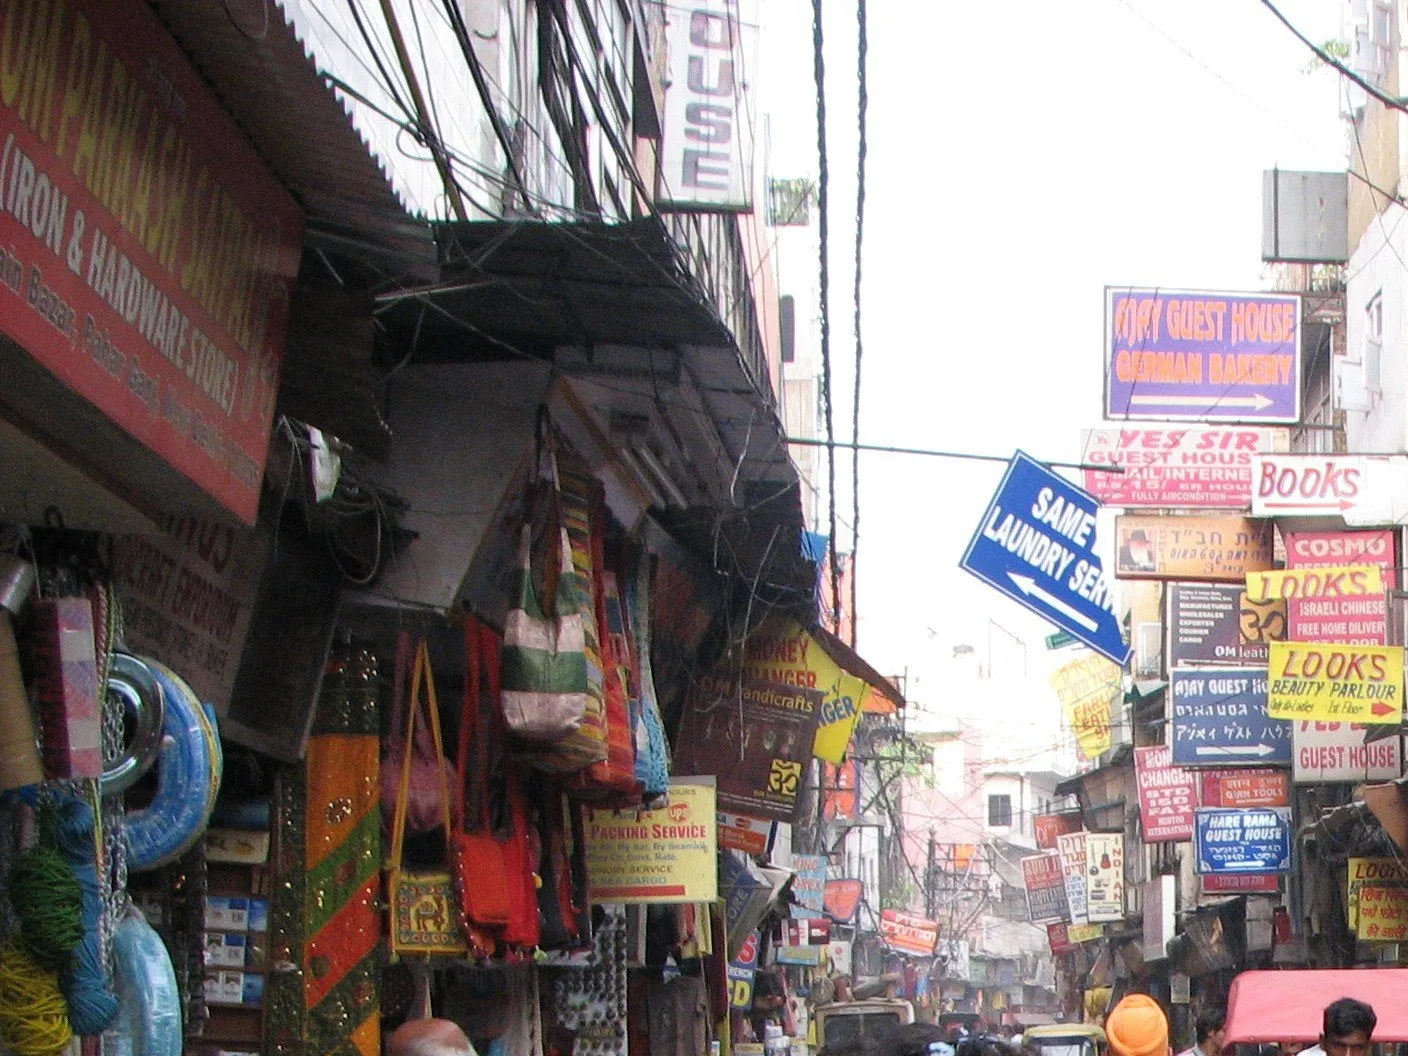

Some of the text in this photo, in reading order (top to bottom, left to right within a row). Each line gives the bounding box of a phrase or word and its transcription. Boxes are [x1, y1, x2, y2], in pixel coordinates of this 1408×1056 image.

[681, 8, 735, 190] OUSE
[87, 227, 189, 372] HARDWARE
[1167, 300, 1227, 342] GUEST
[1231, 301, 1295, 346] HOUSE
[1116, 350, 1293, 385] GERMAN BAKERY
[1120, 429, 1260, 451] YES SIR
[1089, 450, 1251, 466] GUEST HOUS
[1258, 461, 1362, 499] BOOKS
[1031, 486, 1096, 549] SAME
[983, 505, 1076, 582] LAUNDRY
[1294, 538, 1387, 557] COSMO
[1299, 601, 1386, 617] ISRAELI CHINESE
[1297, 622, 1320, 637] FREE
[1322, 622, 1347, 636] HOME
[1214, 645, 1237, 658] OM
[1282, 650, 1388, 682] LOOKS
[1208, 678, 1249, 695] GUEST
[1271, 679, 1326, 698] BEAUTY
[1329, 682, 1397, 700] PARLOUR
[741, 684, 815, 713] andicrafts
[1145, 749, 1171, 769] MON
[1300, 744, 1395, 770] GUEST HOUSE
[1140, 767, 1194, 788] CHANGER
[1145, 787, 1191, 799] STD
[1148, 804, 1193, 816] FAX
[650, 823, 707, 840] SERVICE
[1209, 813, 1277, 829] HARE RAMA
[1205, 827, 1283, 843] GUEST HOUSE
